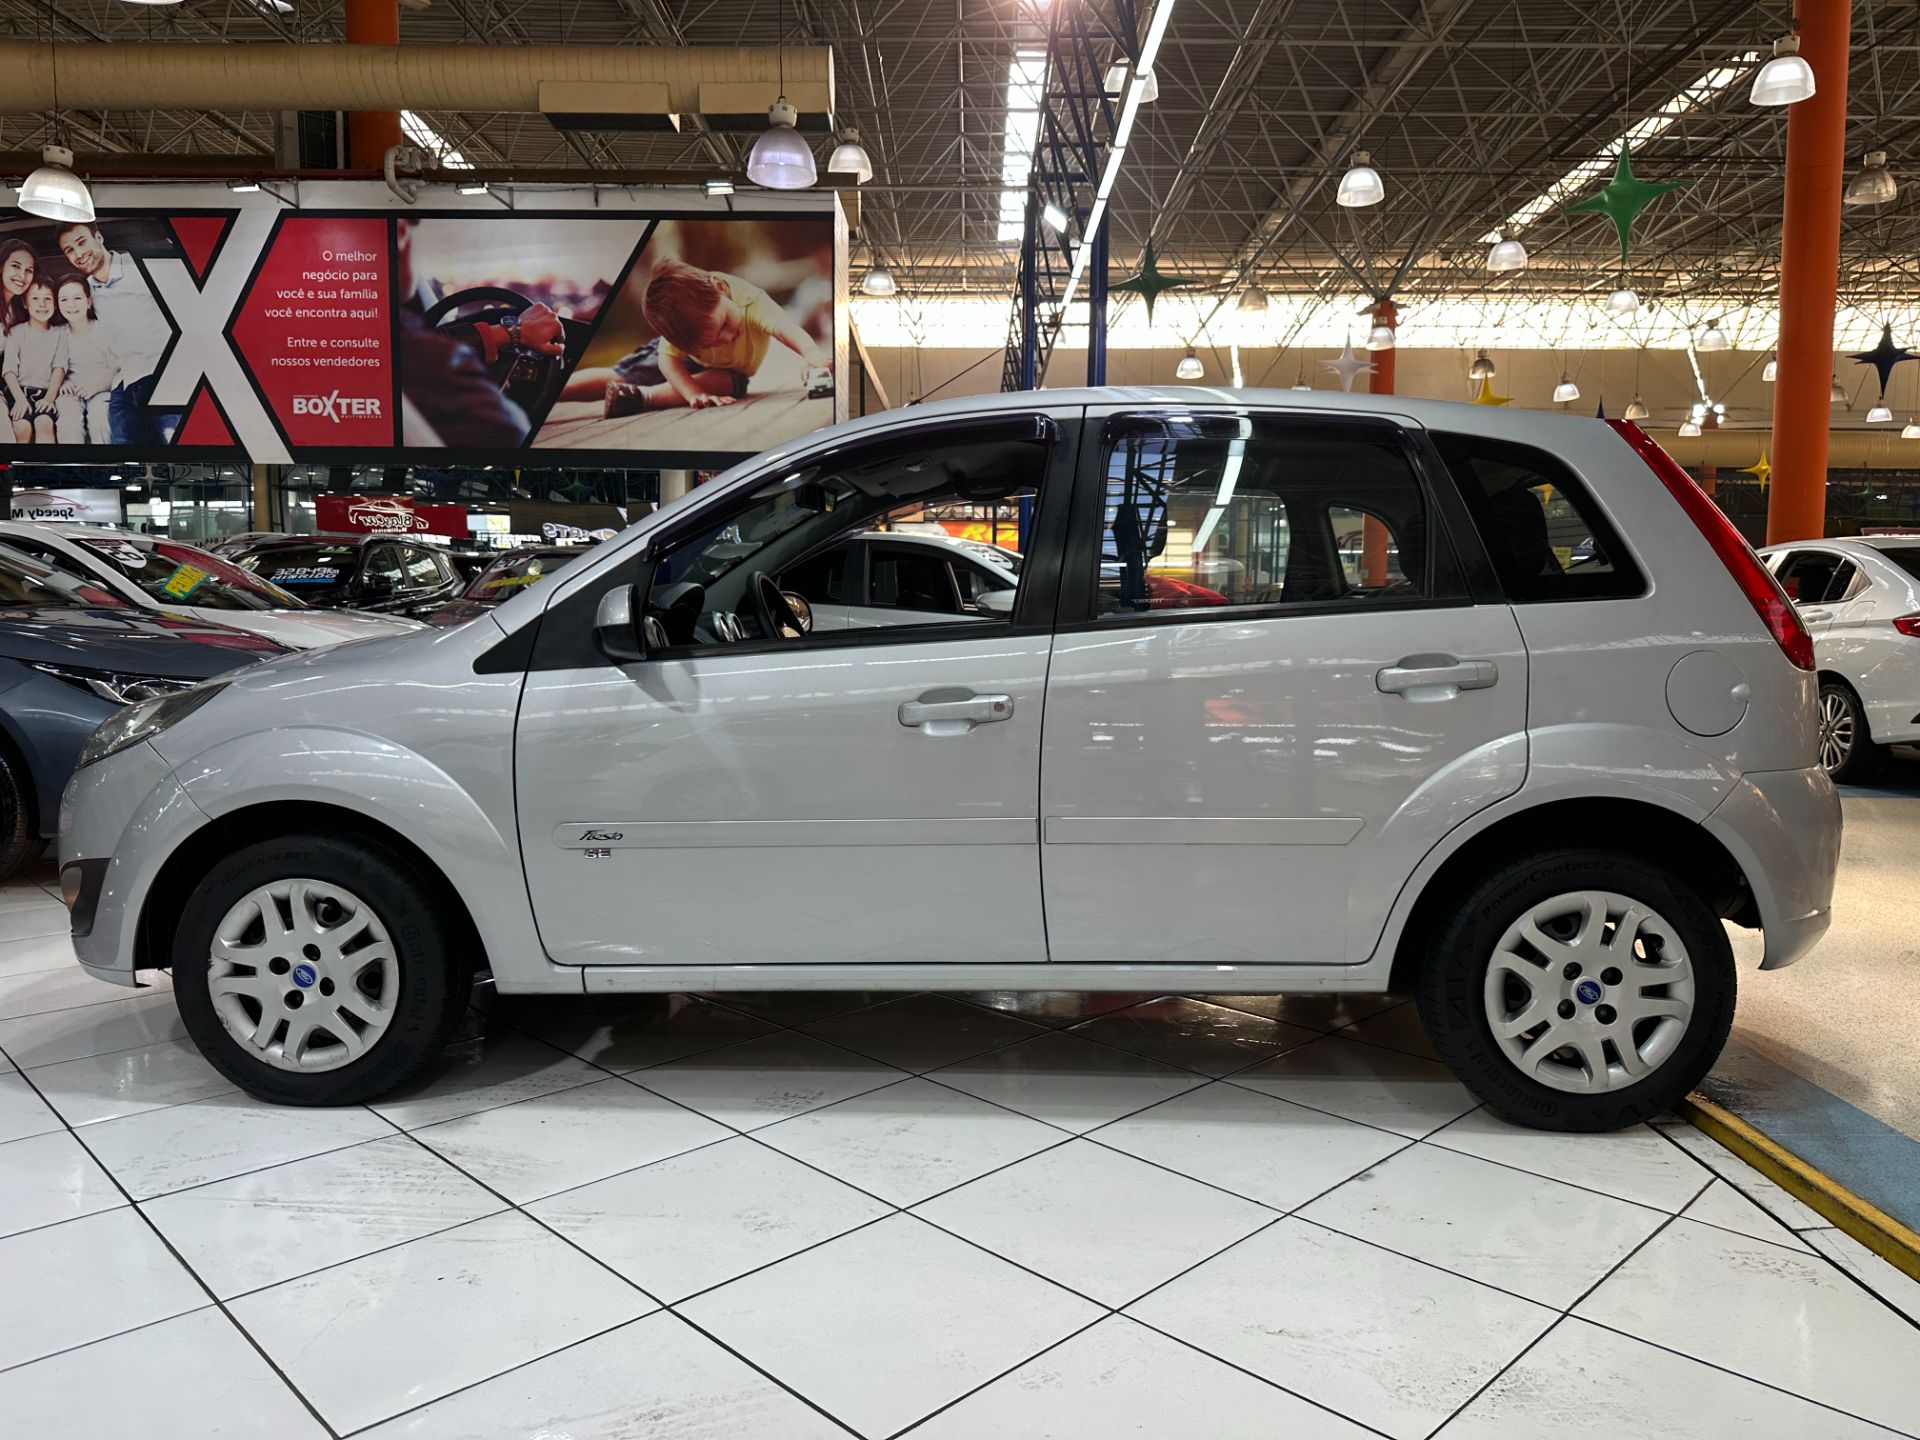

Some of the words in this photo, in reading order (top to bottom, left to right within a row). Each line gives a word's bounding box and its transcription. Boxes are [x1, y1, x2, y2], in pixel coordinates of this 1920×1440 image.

[322, 249, 333, 261] O
[335, 249, 377, 261] melhor
[303, 270, 349, 282] negócio
[353, 272, 377, 282] para
[277, 288, 304, 298] você
[340, 289, 377, 299] família
[265, 307, 292, 317] você
[296, 309, 347, 318] encontra
[350, 308, 377, 320] aqui!
[288, 337, 317, 347] Entre
[330, 338, 379, 348] consulte
[272, 358, 310, 366] nossos
[313, 356, 380, 366] vendedores
[293, 389, 381, 423] BOXTER
[578, 829, 624, 841] Fiesta
[584, 848, 612, 860] SE
[1482, 861, 1604, 918] PowerContact
